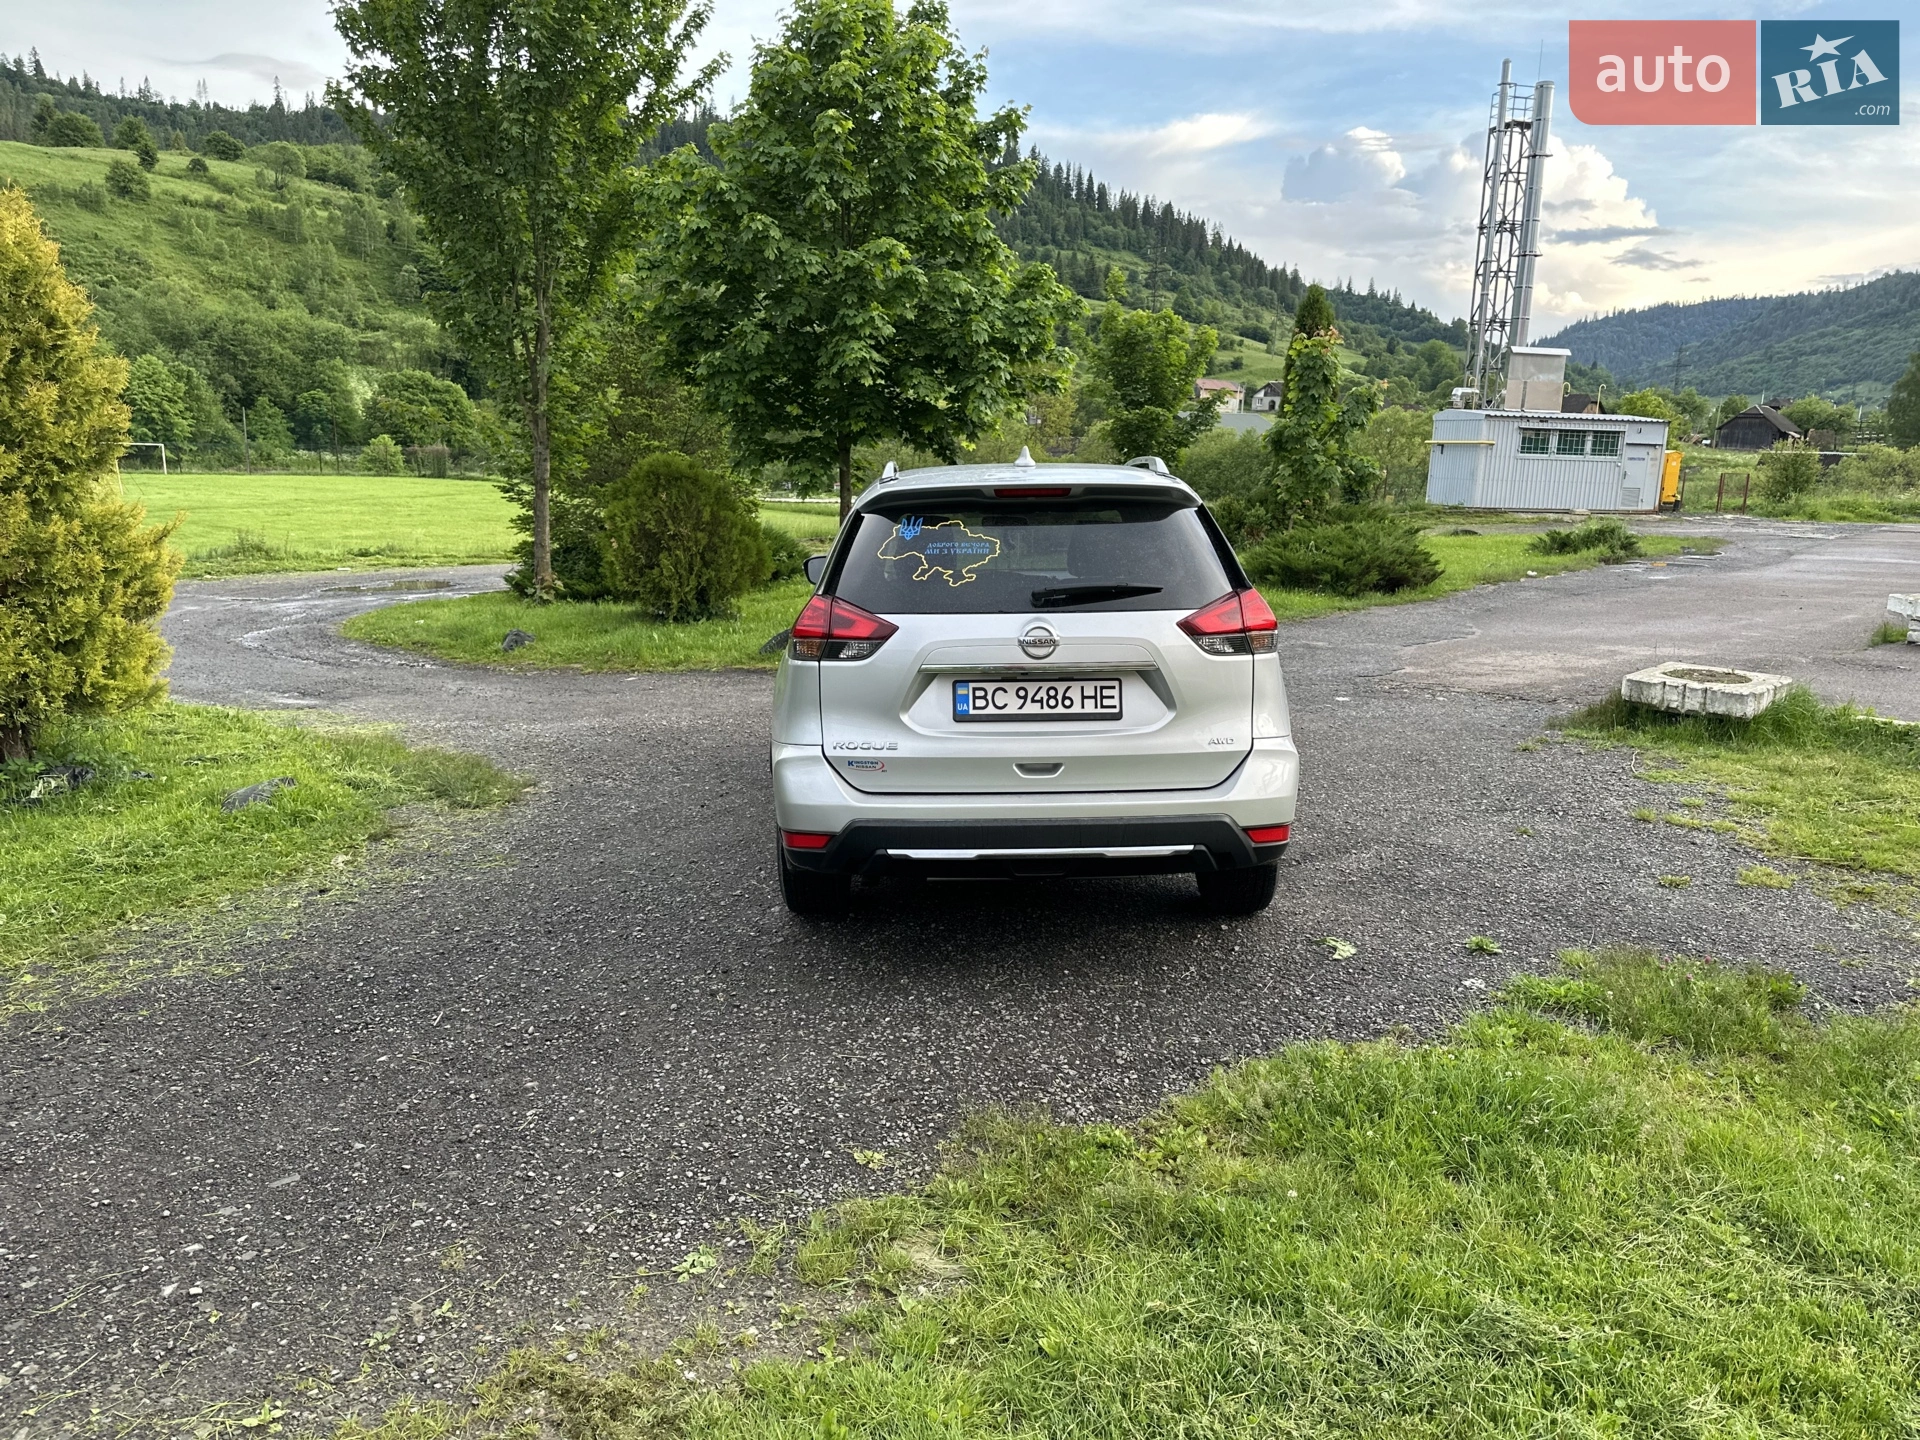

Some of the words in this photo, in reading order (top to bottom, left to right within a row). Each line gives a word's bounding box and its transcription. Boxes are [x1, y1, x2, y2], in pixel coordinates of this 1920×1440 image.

[950, 547, 990, 555] УКРАЇНИ
[971, 686, 1009, 710] BC
[1015, 686, 1074, 710] 9486
[1080, 686, 1117, 710] HE
[832, 741, 898, 750] ROGUE
